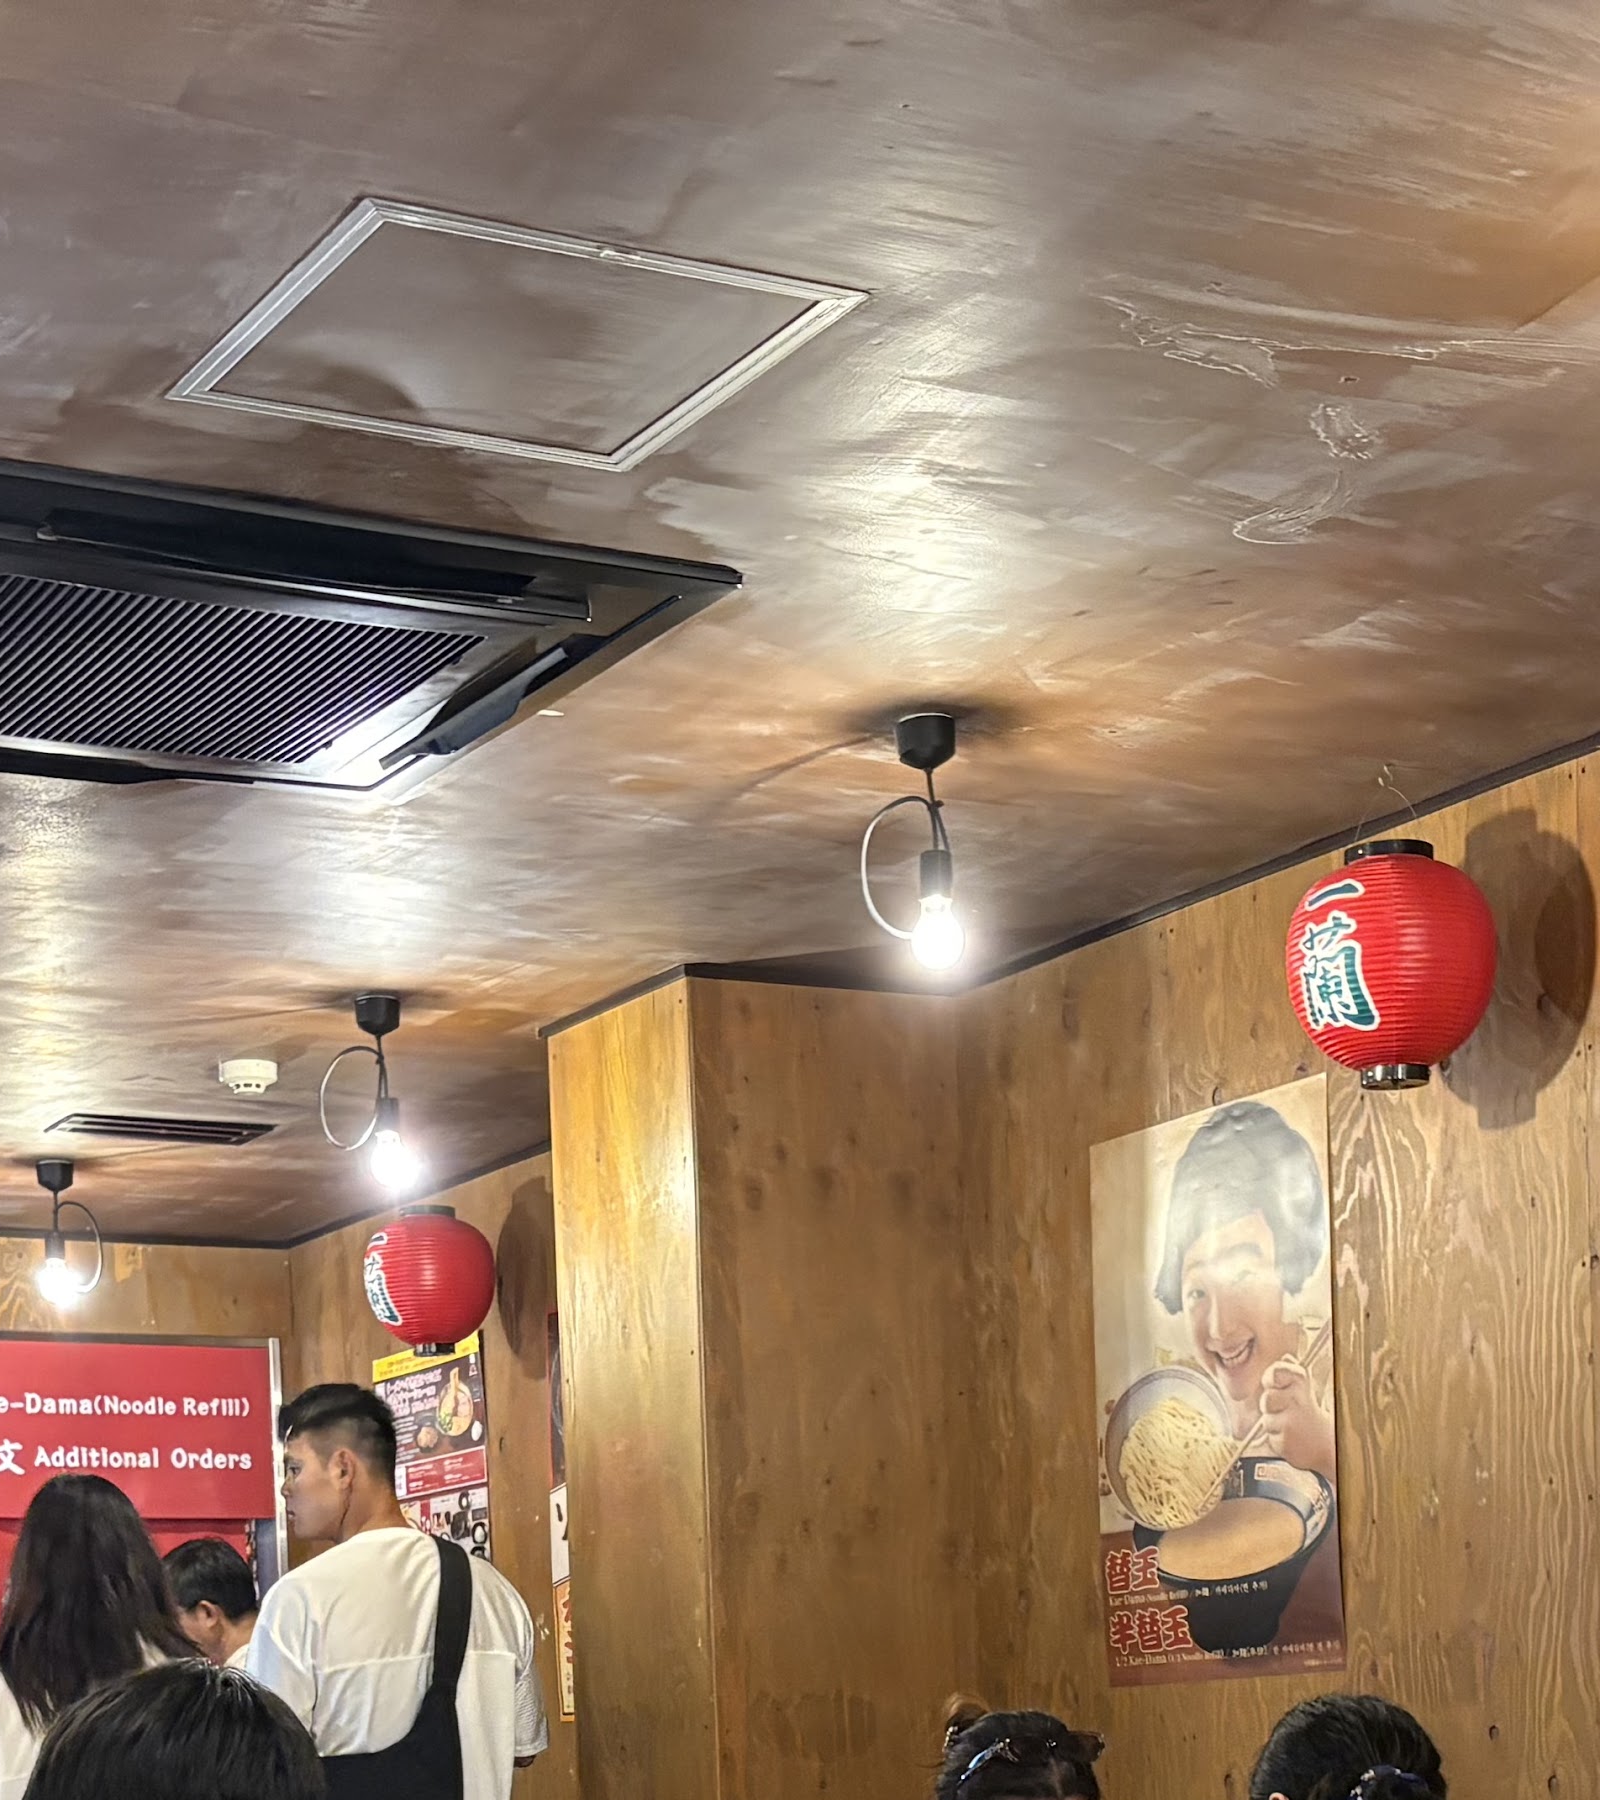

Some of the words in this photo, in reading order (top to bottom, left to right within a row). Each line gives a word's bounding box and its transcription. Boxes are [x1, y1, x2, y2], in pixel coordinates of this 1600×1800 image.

[1300, 878, 1381, 1031] 一蘭
[182, 1397, 250, 1417] Refill)
[34, 1445, 160, 1469] Additional
[170, 1447, 252, 1470] Orders
[1105, 1545, 1160, 1594] 替玉
[1109, 1604, 1193, 1655] 半替玉
